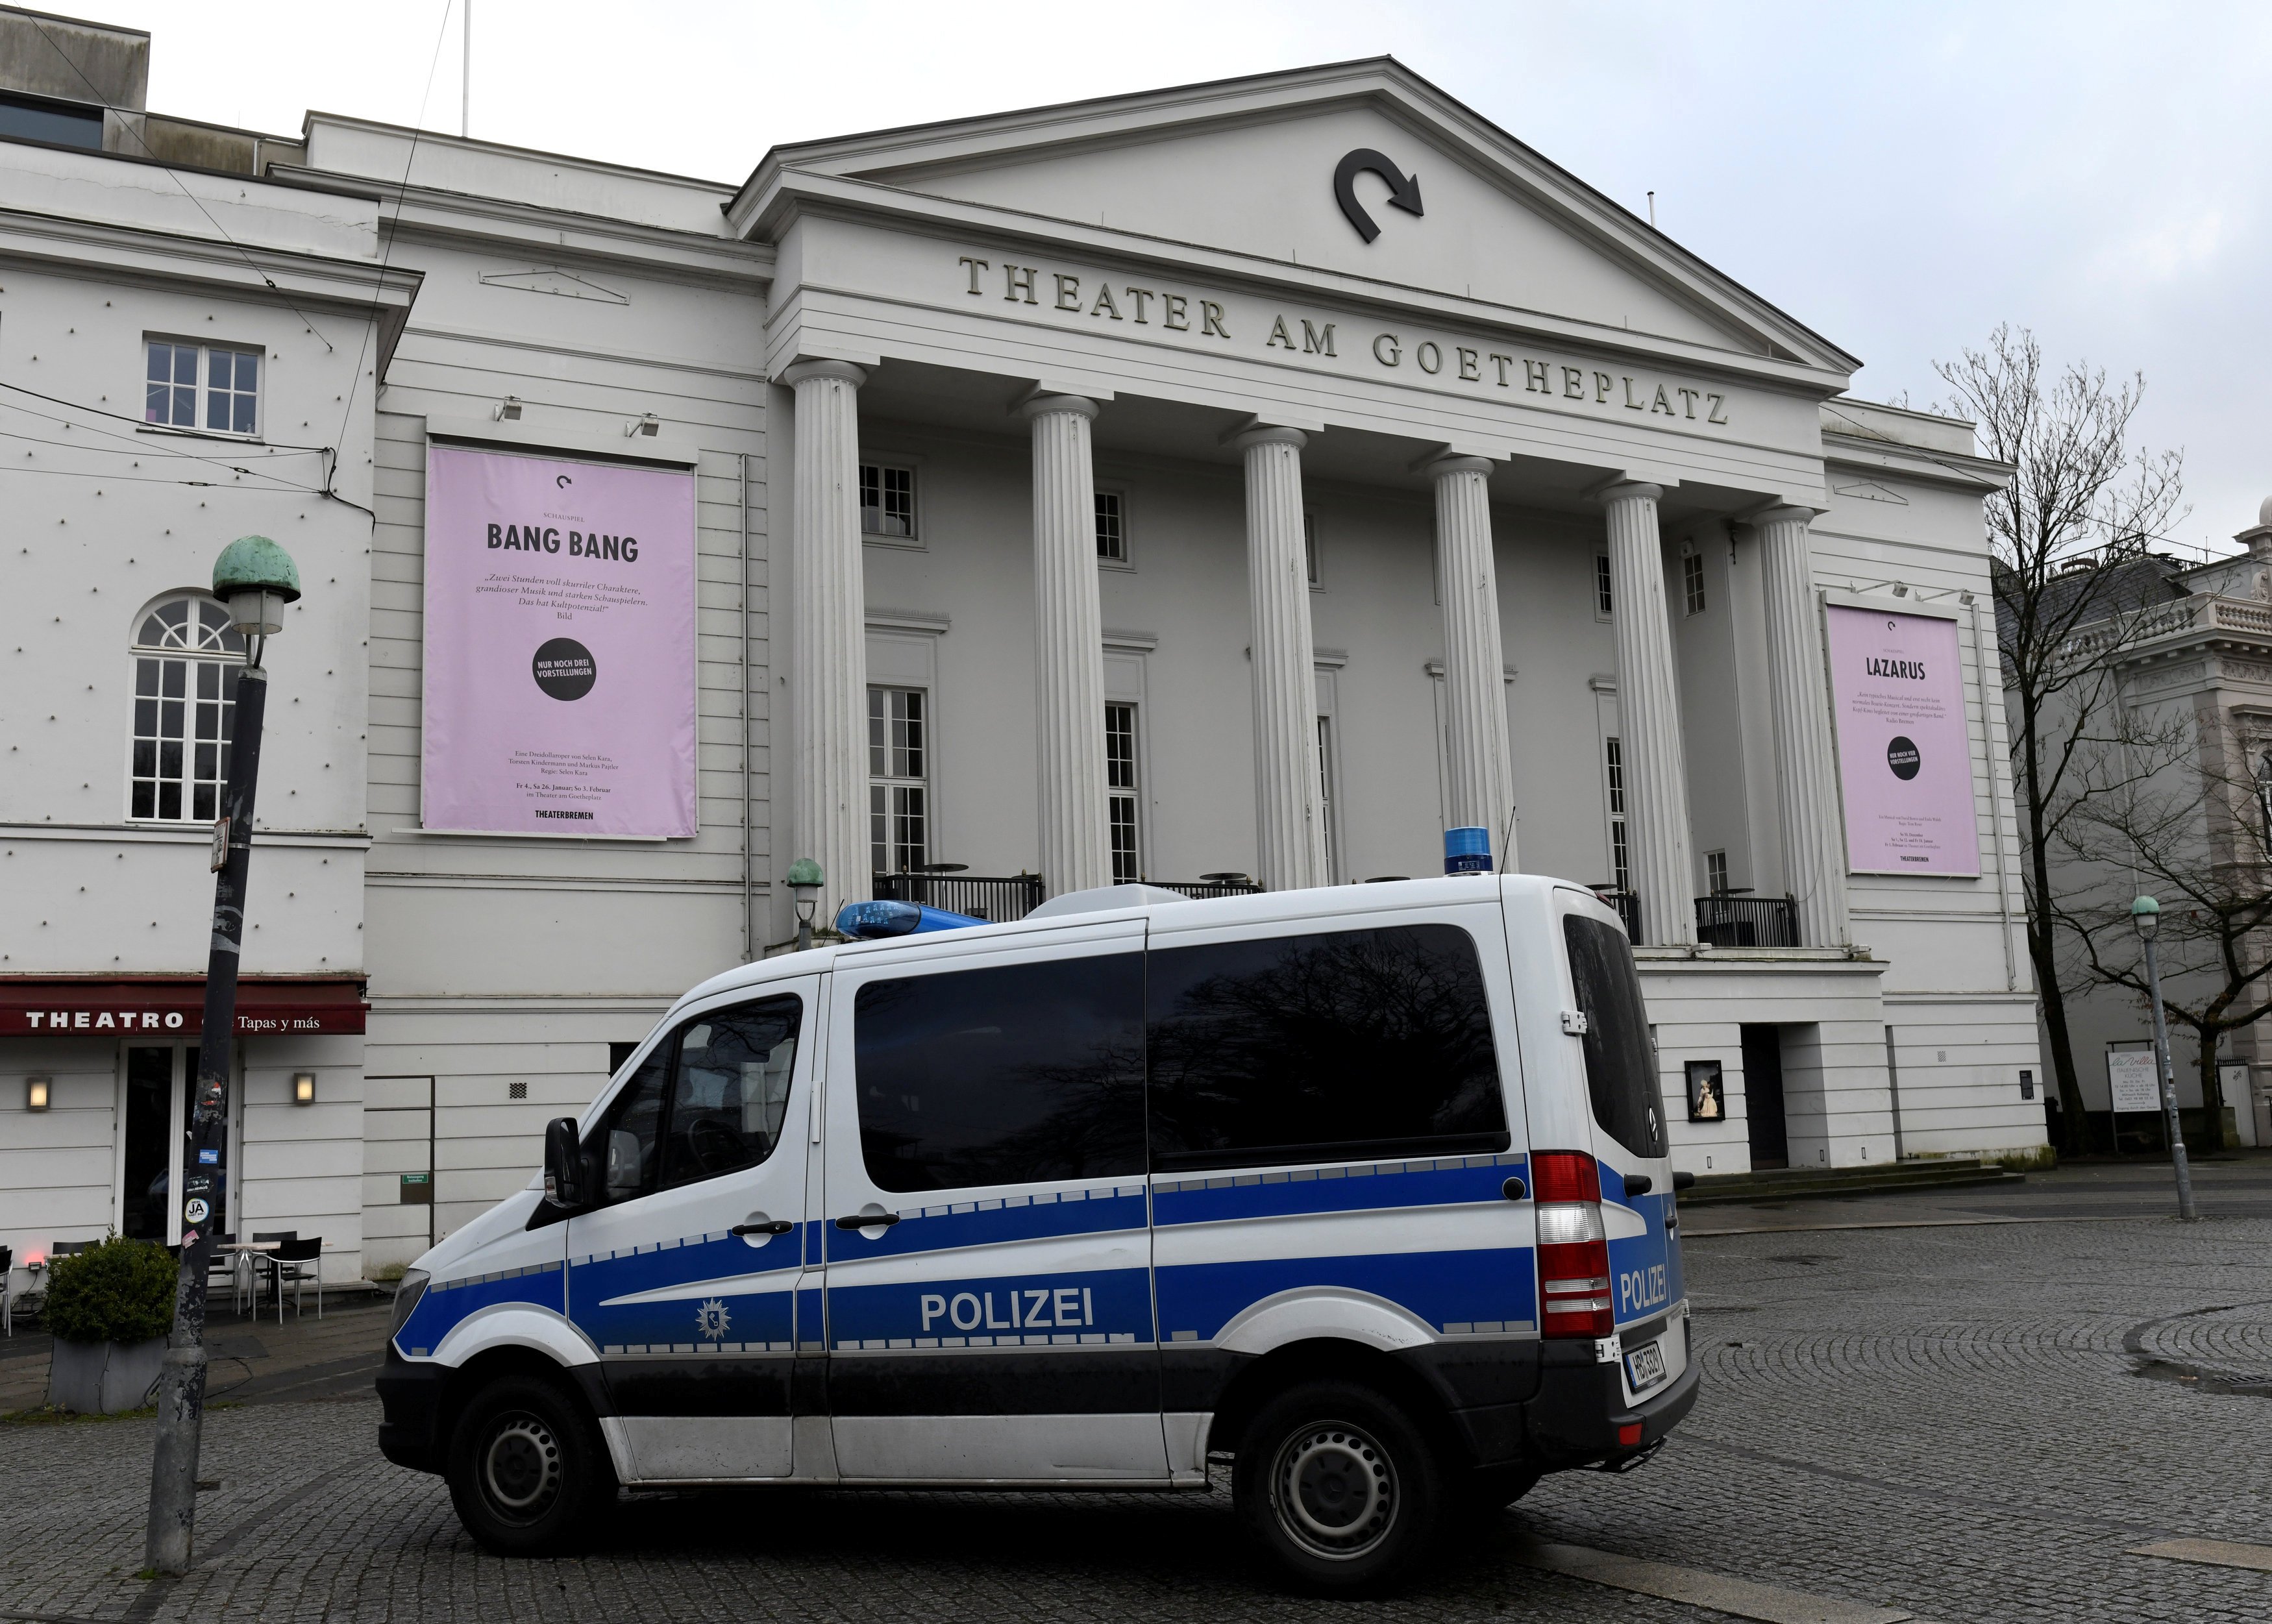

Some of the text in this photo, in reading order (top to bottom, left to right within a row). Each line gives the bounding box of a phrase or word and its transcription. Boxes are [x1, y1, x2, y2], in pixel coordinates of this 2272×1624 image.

[959, 256, 1729, 424] THEATER AM GOETHEPLATZ
[543, 512, 585, 522] SCHAUSPIEL
[487, 523, 638, 563] BANG BANG
[512, 575, 544, 584] Stunden
[562, 579, 595, 590] skurriler
[597, 583, 641, 595] Charaktere,
[476, 585, 519, 593] grandioser
[521, 587, 546, 596] Musik
[565, 591, 592, 600] starken
[594, 594, 648, 606] Schauspielern.
[557, 612, 572, 620] Bild
[537, 668, 592, 678] VORSTELLUNGEN
[1866, 657, 1925, 680] LAZARUS
[529, 751, 570, 759] Dreidollaroper
[1890, 756, 1918, 765] VORSTELLUNGEN
[535, 810, 593, 820] THEATERBREMEN
[26, 1012, 183, 1028] THEATRO
[238, 1016, 276, 1032] Tapas
[281, 1020, 290, 1031] y
[293, 1016, 320, 1029] más
[189, 1203, 204, 1213] JA
[1620, 1263, 1666, 1313] POLIZEI
[921, 1288, 1093, 1331] POLIZEI
[1633, 1354, 1645, 1381] HB
